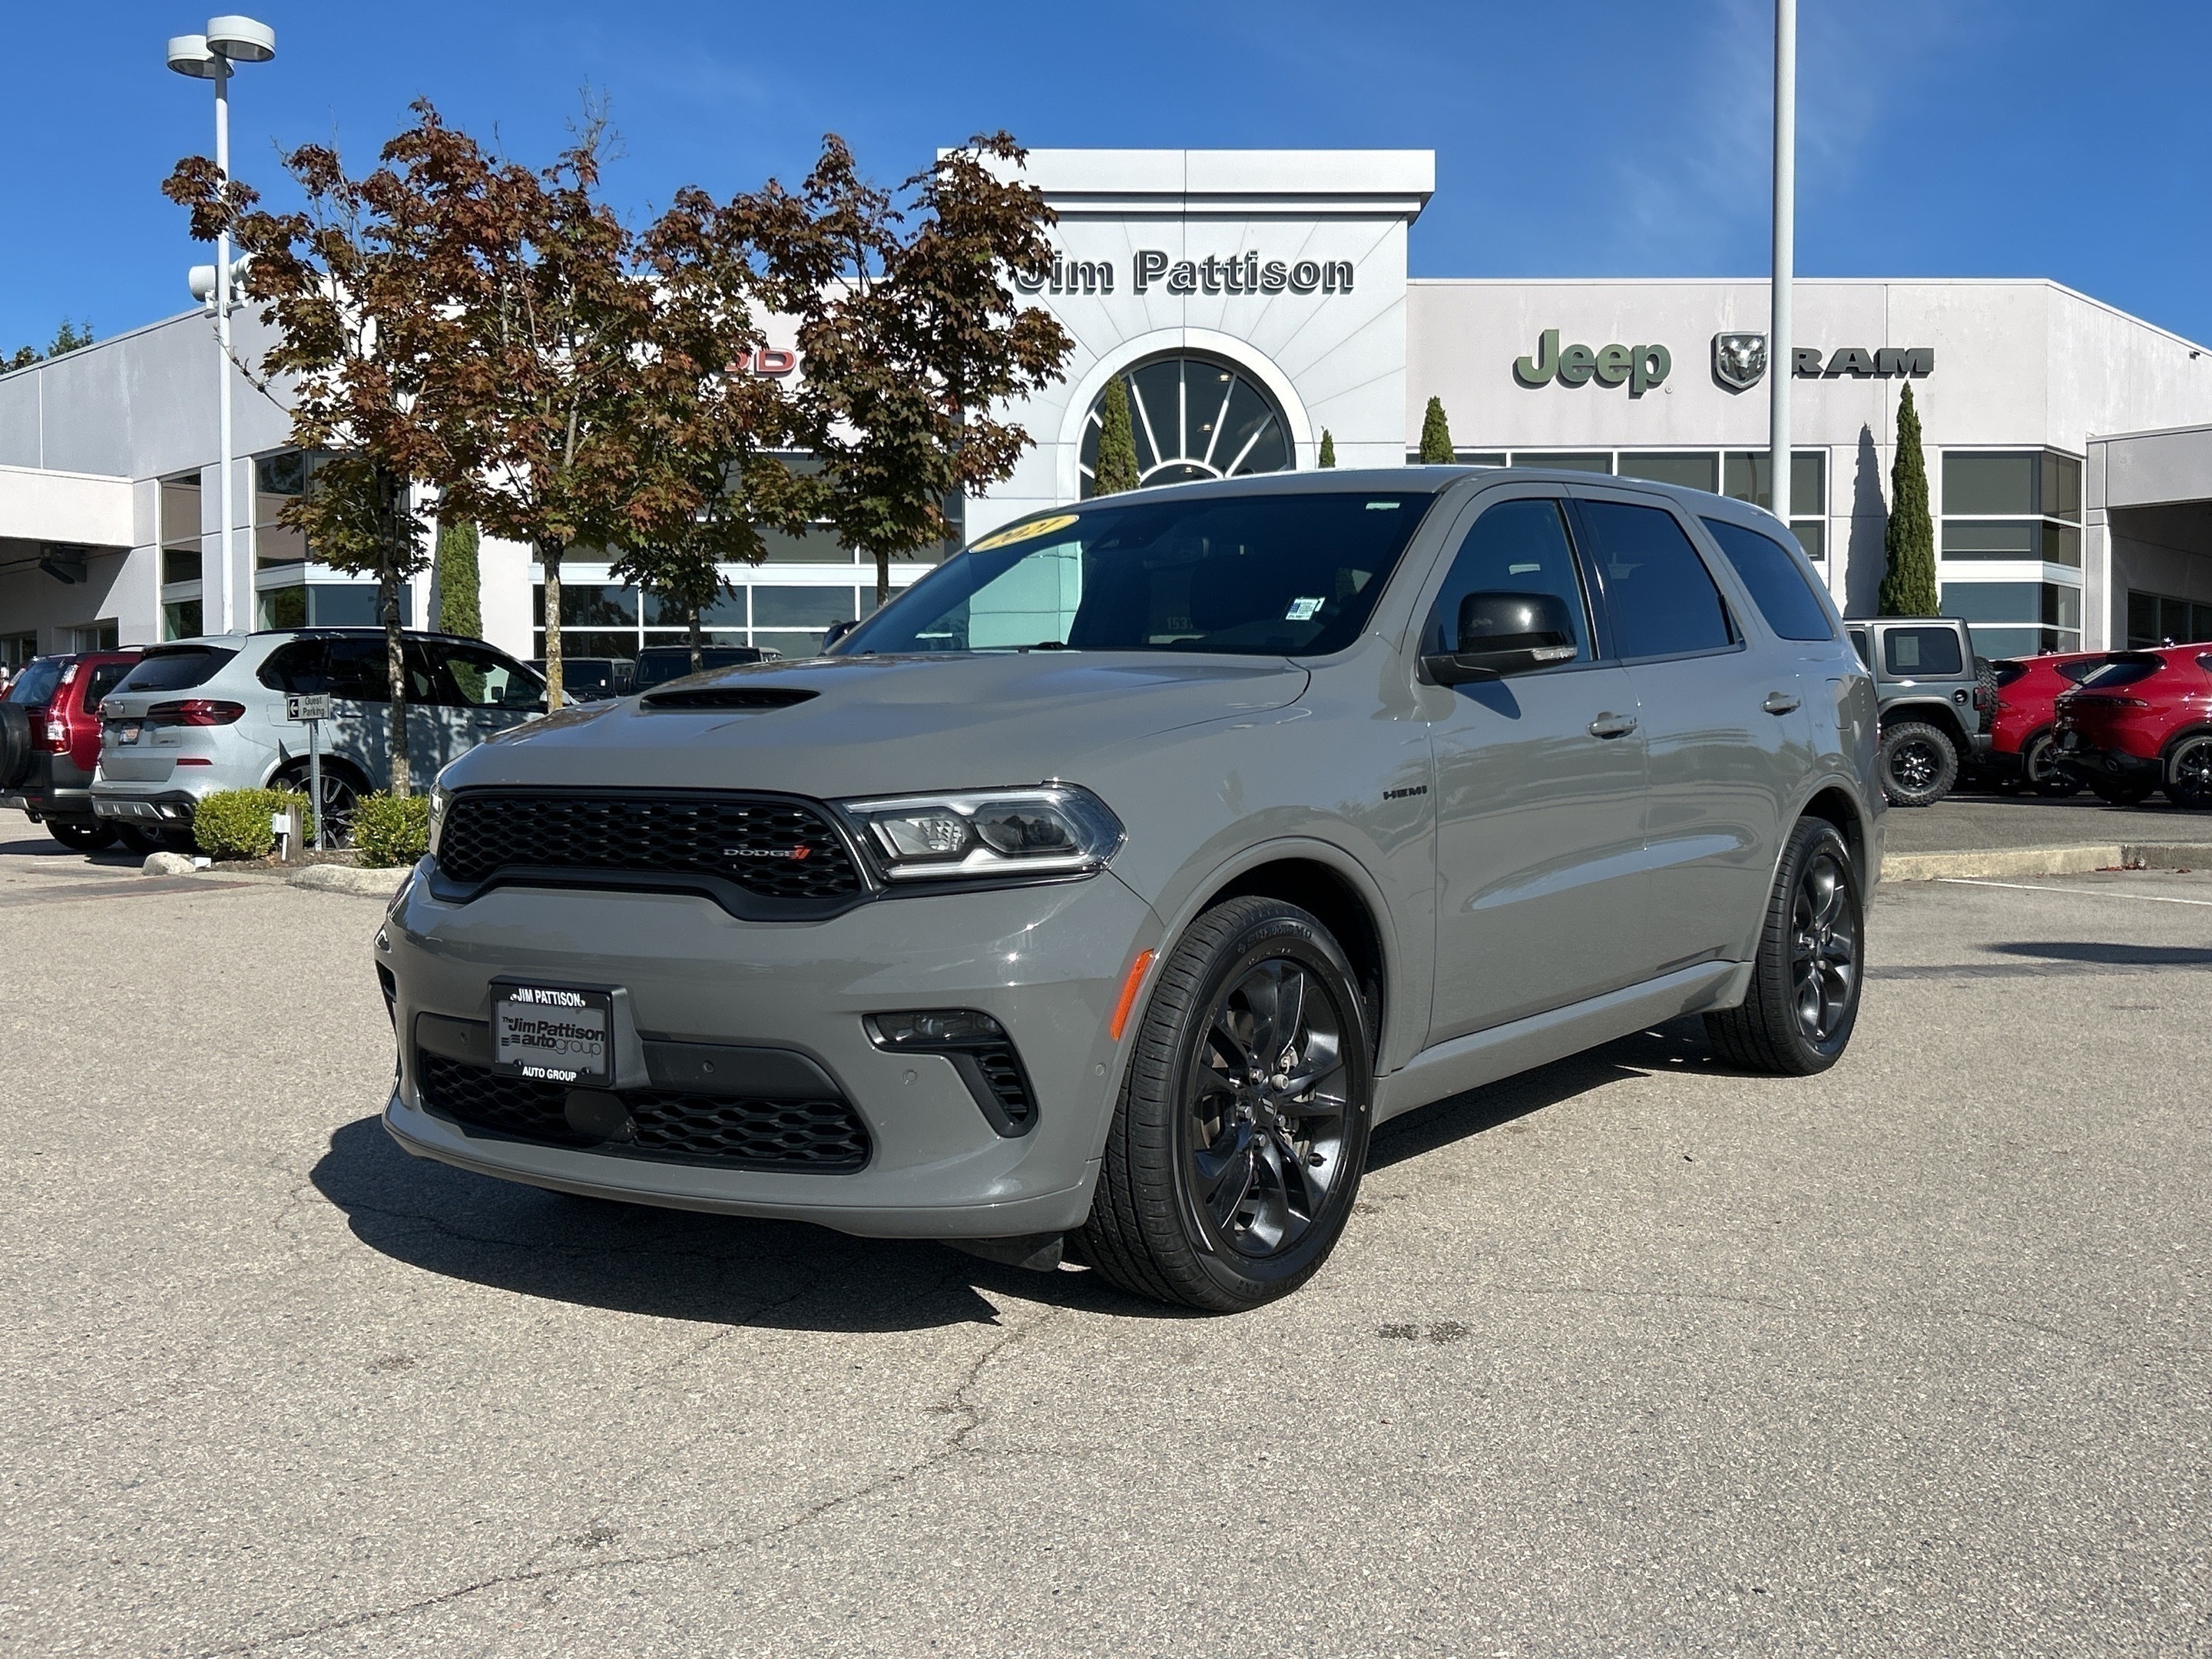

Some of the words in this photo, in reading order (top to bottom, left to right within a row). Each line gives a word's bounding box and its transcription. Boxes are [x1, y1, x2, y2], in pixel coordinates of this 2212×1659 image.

[1133, 250, 1355, 295] Pattison
[1514, 329, 1671, 399] Jeep
[1792, 348, 1934, 379] RAM
[305, 696, 322, 705] Guest
[303, 707, 324, 717] Parking
[1383, 786, 1427, 800] HEMI
[724, 849, 800, 858] DODGE
[518, 988, 533, 1003] JIM
[535, 989, 581, 1007] PATTISON
[508, 1018, 536, 1034] Jim
[537, 1021, 605, 1041] Pattison
[522, 1066, 545, 1078] AUTO
[547, 1069, 577, 1081] GROUP
